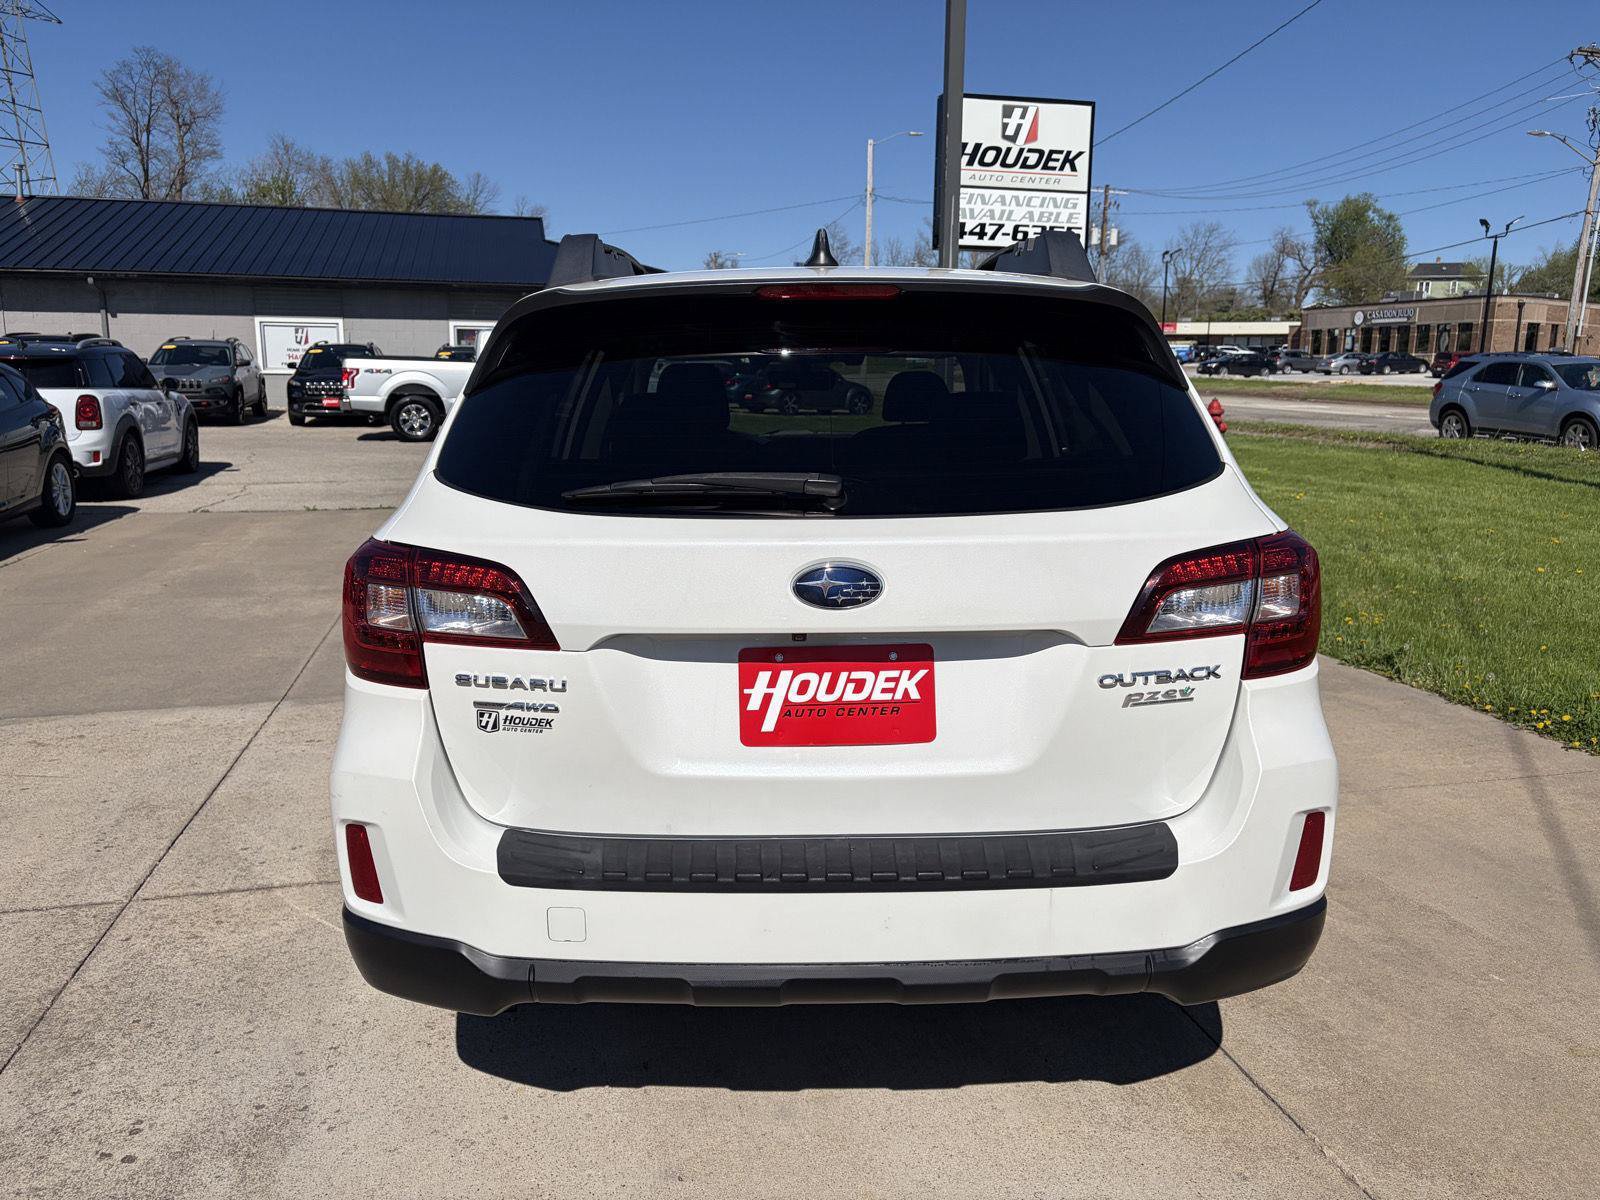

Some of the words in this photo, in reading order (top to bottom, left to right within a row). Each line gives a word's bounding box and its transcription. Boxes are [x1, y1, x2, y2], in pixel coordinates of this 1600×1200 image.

[961, 142, 1086, 172] HOUDEK
[968, 174, 1004, 183] AUTO
[1010, 175, 1062, 185] CENTER
[960, 192, 1079, 210] FINANCING
[959, 208, 1081, 224] AVAILABLE
[1367, 311, 1383, 319] CASA
[454, 674, 567, 693] SUBARU
[1098, 664, 1222, 689] OUTBACK
[503, 701, 560, 713] AWD
[743, 669, 929, 732] HOUDEK
[782, 707, 827, 718] AUTO
[835, 706, 901, 717] CENTER
[502, 715, 555, 728] HOUDEK
